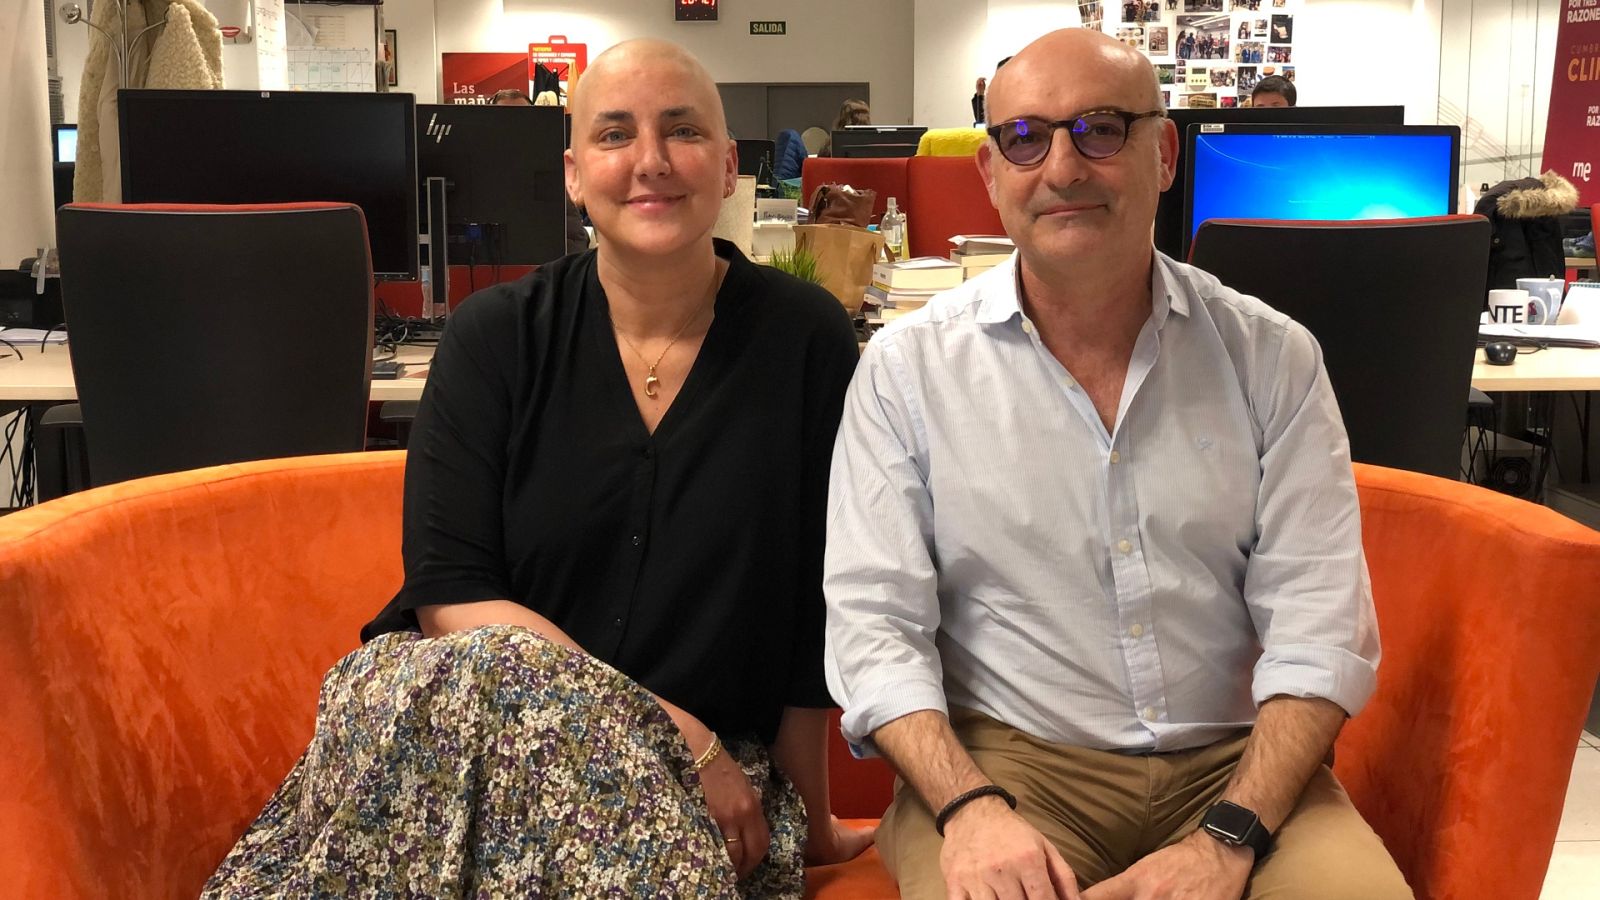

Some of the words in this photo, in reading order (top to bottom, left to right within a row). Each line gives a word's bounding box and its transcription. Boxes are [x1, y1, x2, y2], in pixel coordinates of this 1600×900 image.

[752, 23, 783, 33] SALIDA
[453, 82, 475, 94] Las
[454, 94, 493, 105] mañ
[1587, 105, 1599, 114] POR
[1572, 161, 1592, 182] rne
